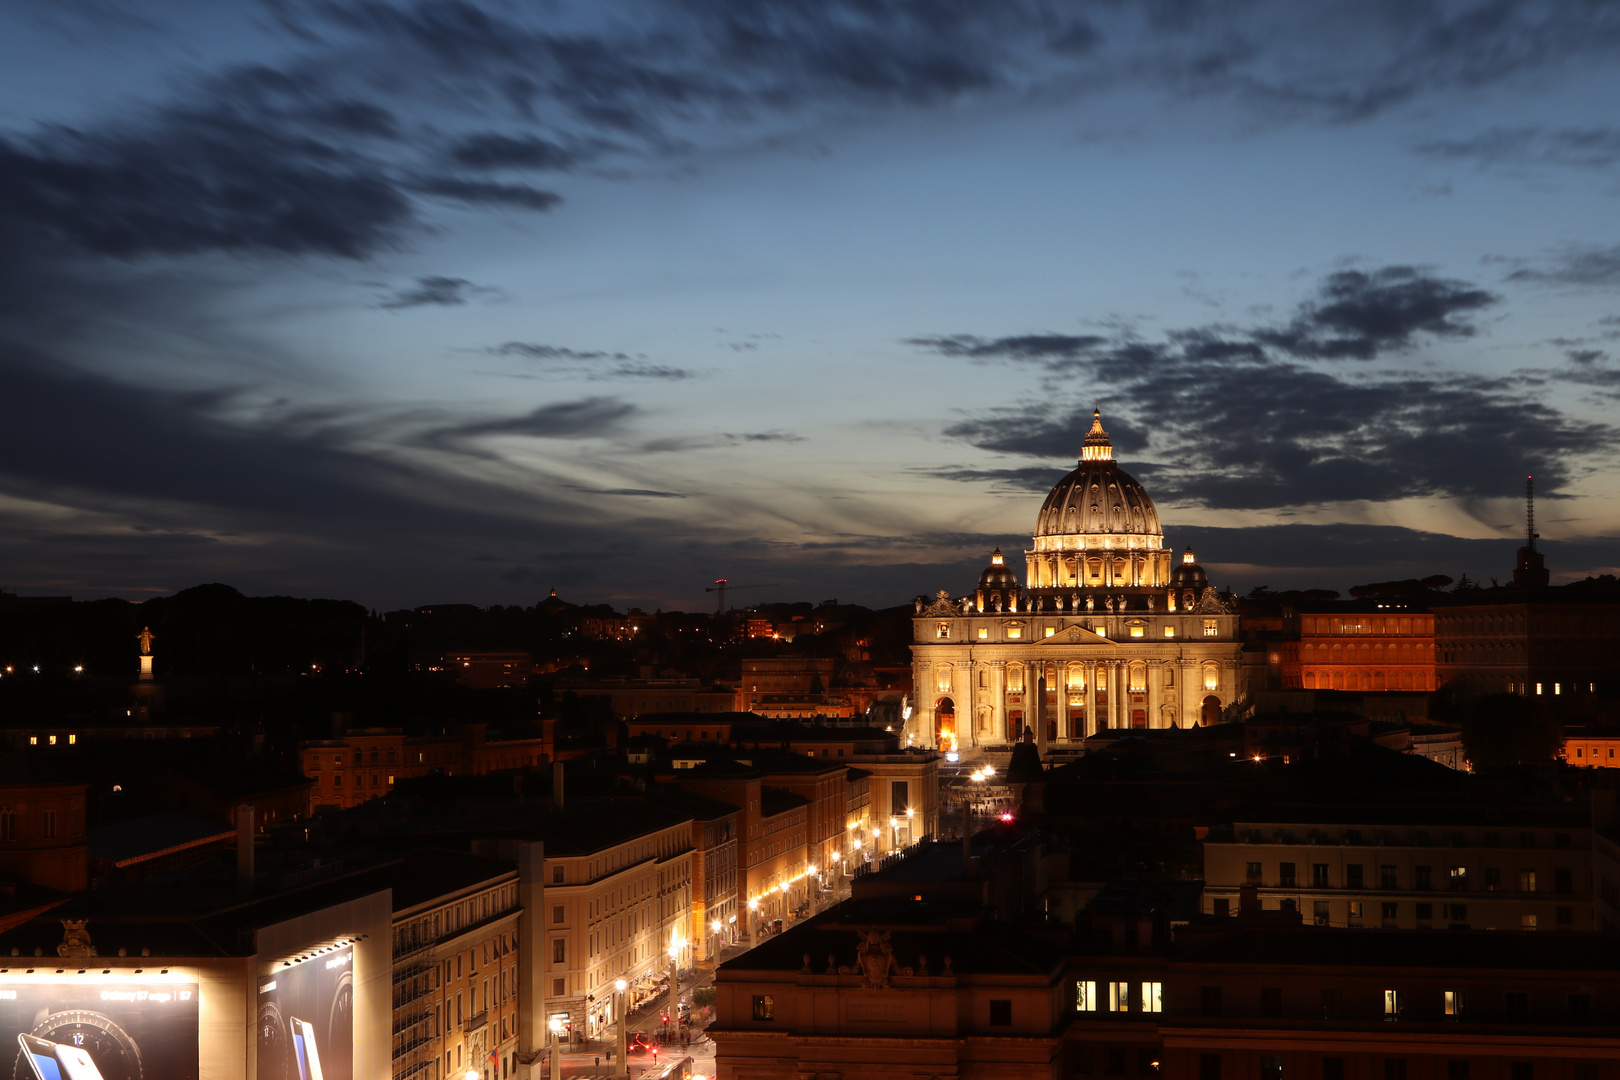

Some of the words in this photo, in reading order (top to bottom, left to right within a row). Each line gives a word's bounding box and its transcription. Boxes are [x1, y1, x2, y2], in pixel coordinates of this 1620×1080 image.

[100, 990, 136, 1003] Galaxy
[179, 991, 191, 1001] S7
[73, 1035, 84, 1045] 12
